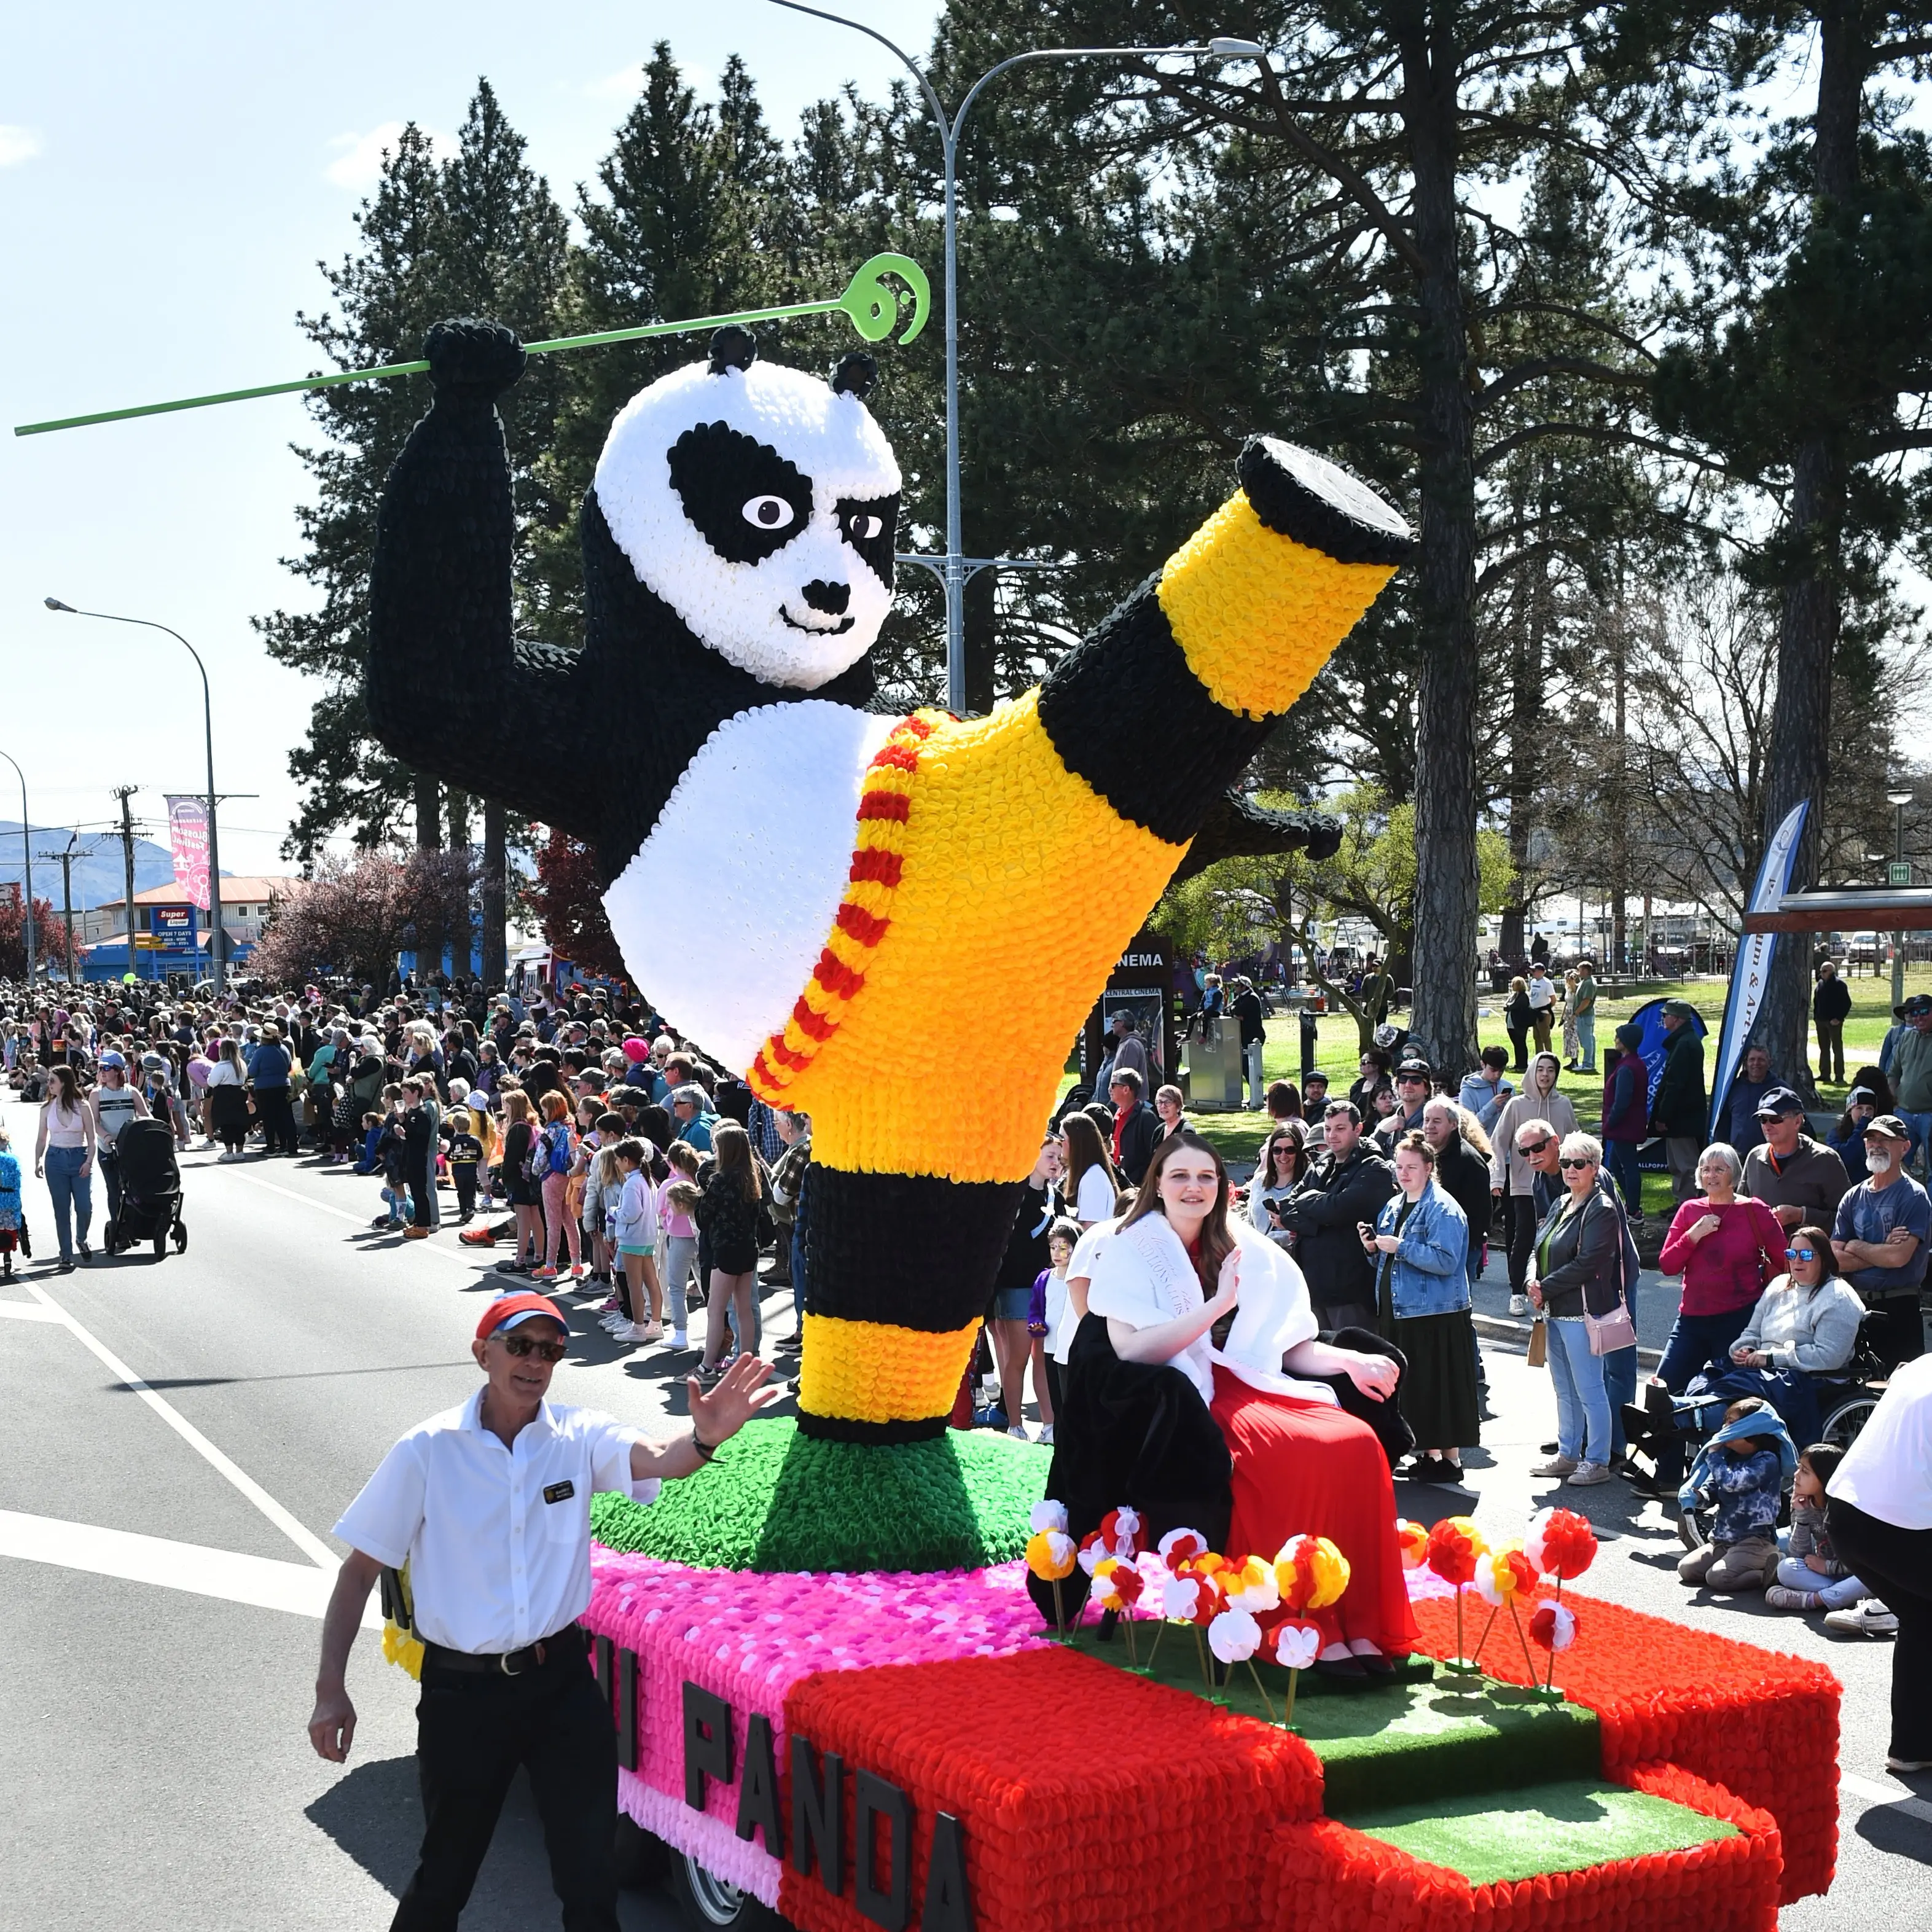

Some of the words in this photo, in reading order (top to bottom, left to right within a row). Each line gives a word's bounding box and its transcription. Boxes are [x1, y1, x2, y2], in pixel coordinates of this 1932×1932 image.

[1117, 953, 1164, 967] NEMA
[1744, 993, 1756, 1028] Art
[1147, 1256, 1168, 1284] LIONS
[682, 1680, 980, 1932] PANDA
